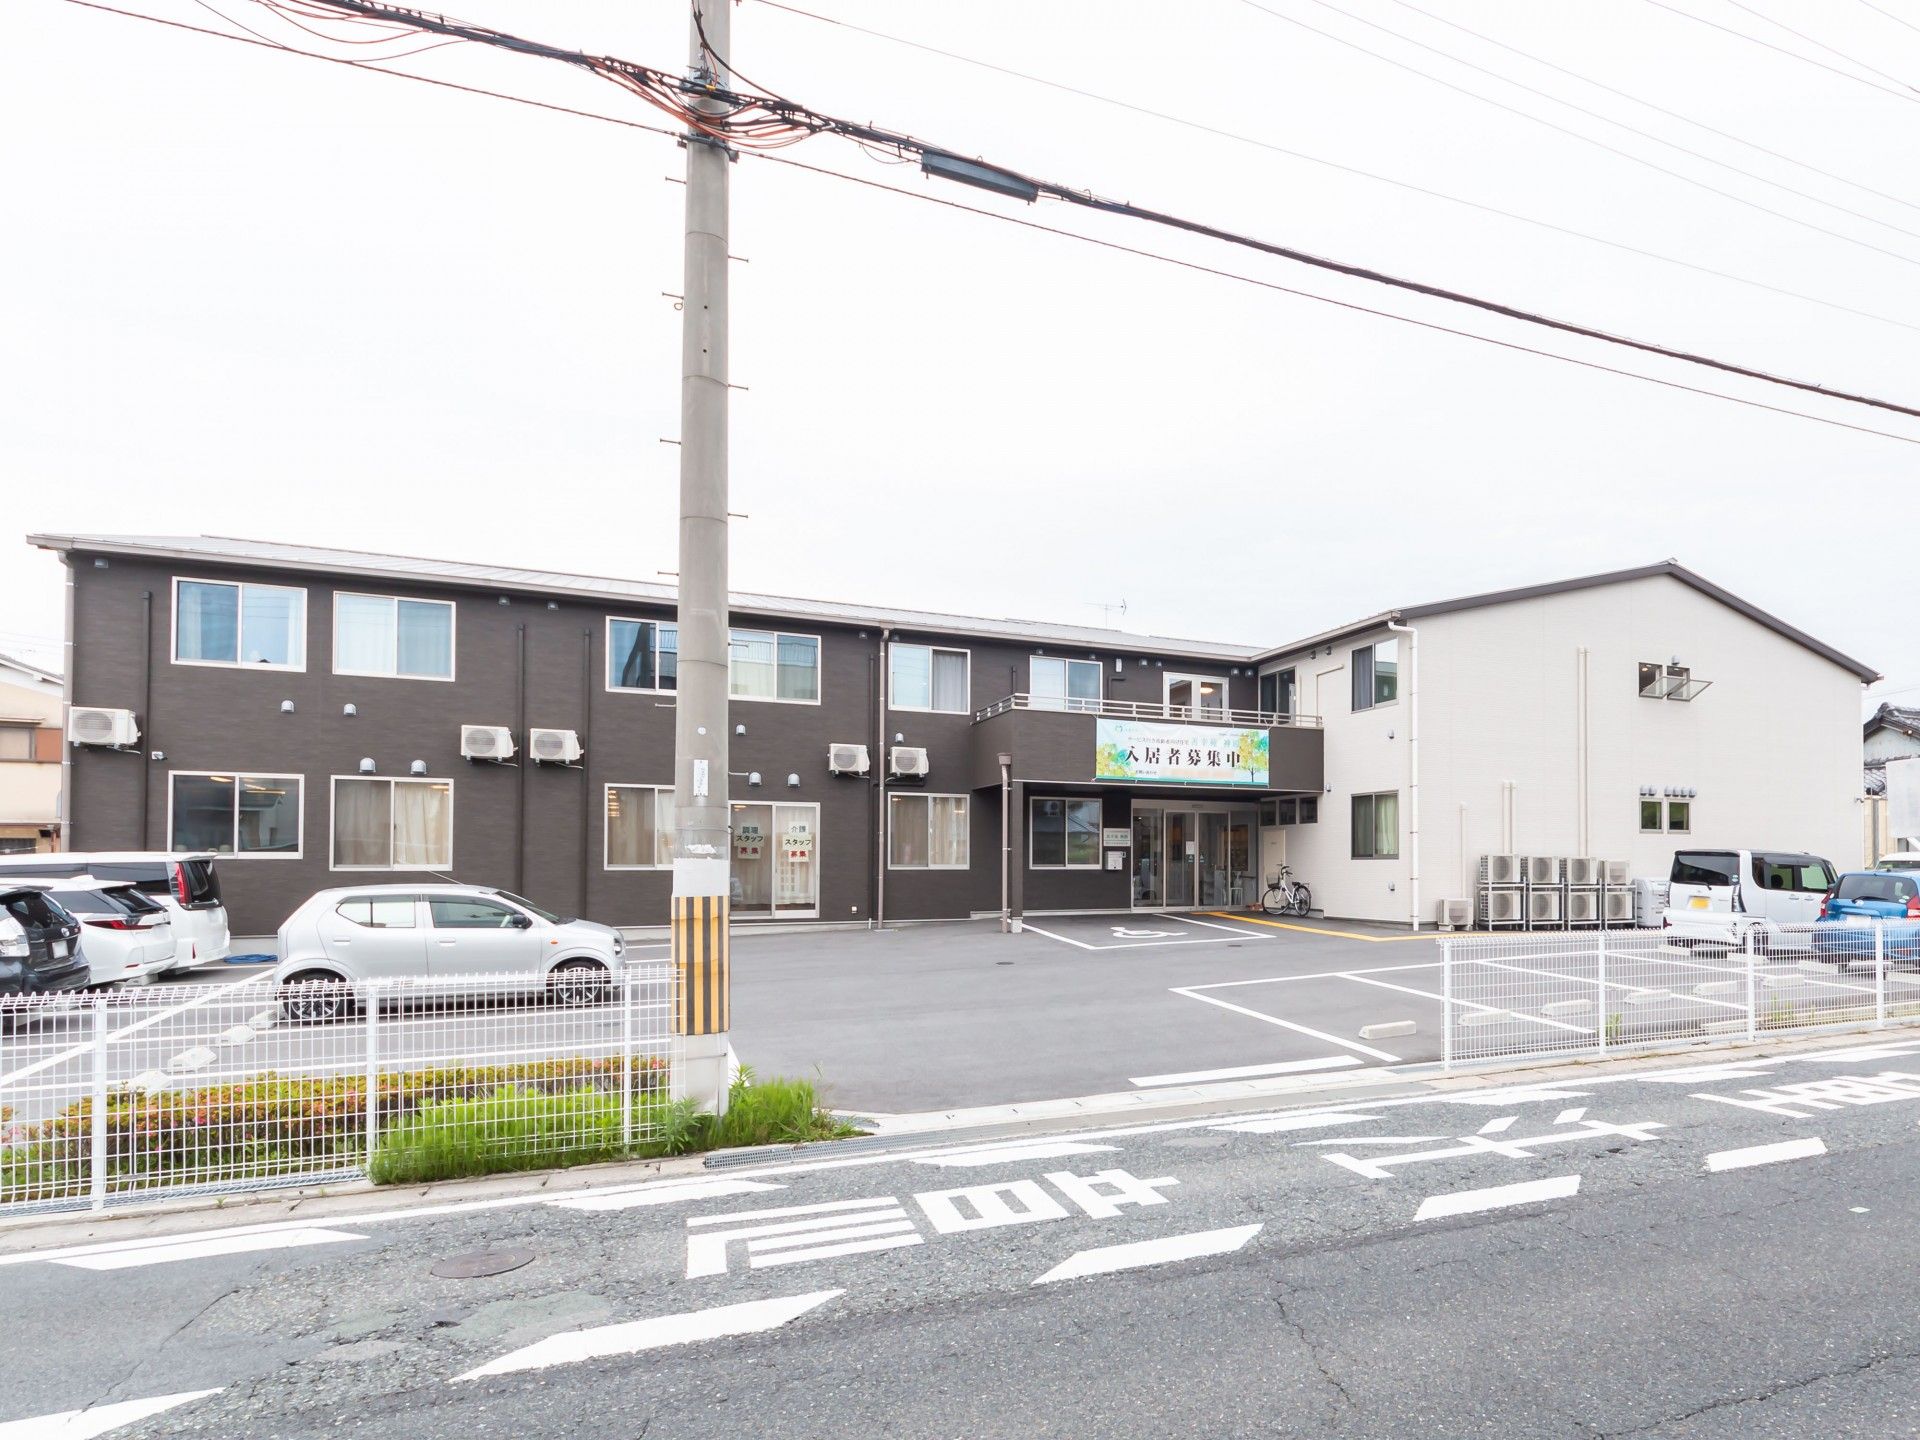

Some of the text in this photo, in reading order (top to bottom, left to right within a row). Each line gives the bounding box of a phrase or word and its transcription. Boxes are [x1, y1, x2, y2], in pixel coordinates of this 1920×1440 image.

[1125, 745, 1241, 768] 入居者募集中
[742, 826, 759, 834] 調理
[791, 825, 807, 833] 介護
[736, 835, 764, 843] スタッフ
[740, 847, 759, 855] 募集
[790, 850, 807, 858] 募集
